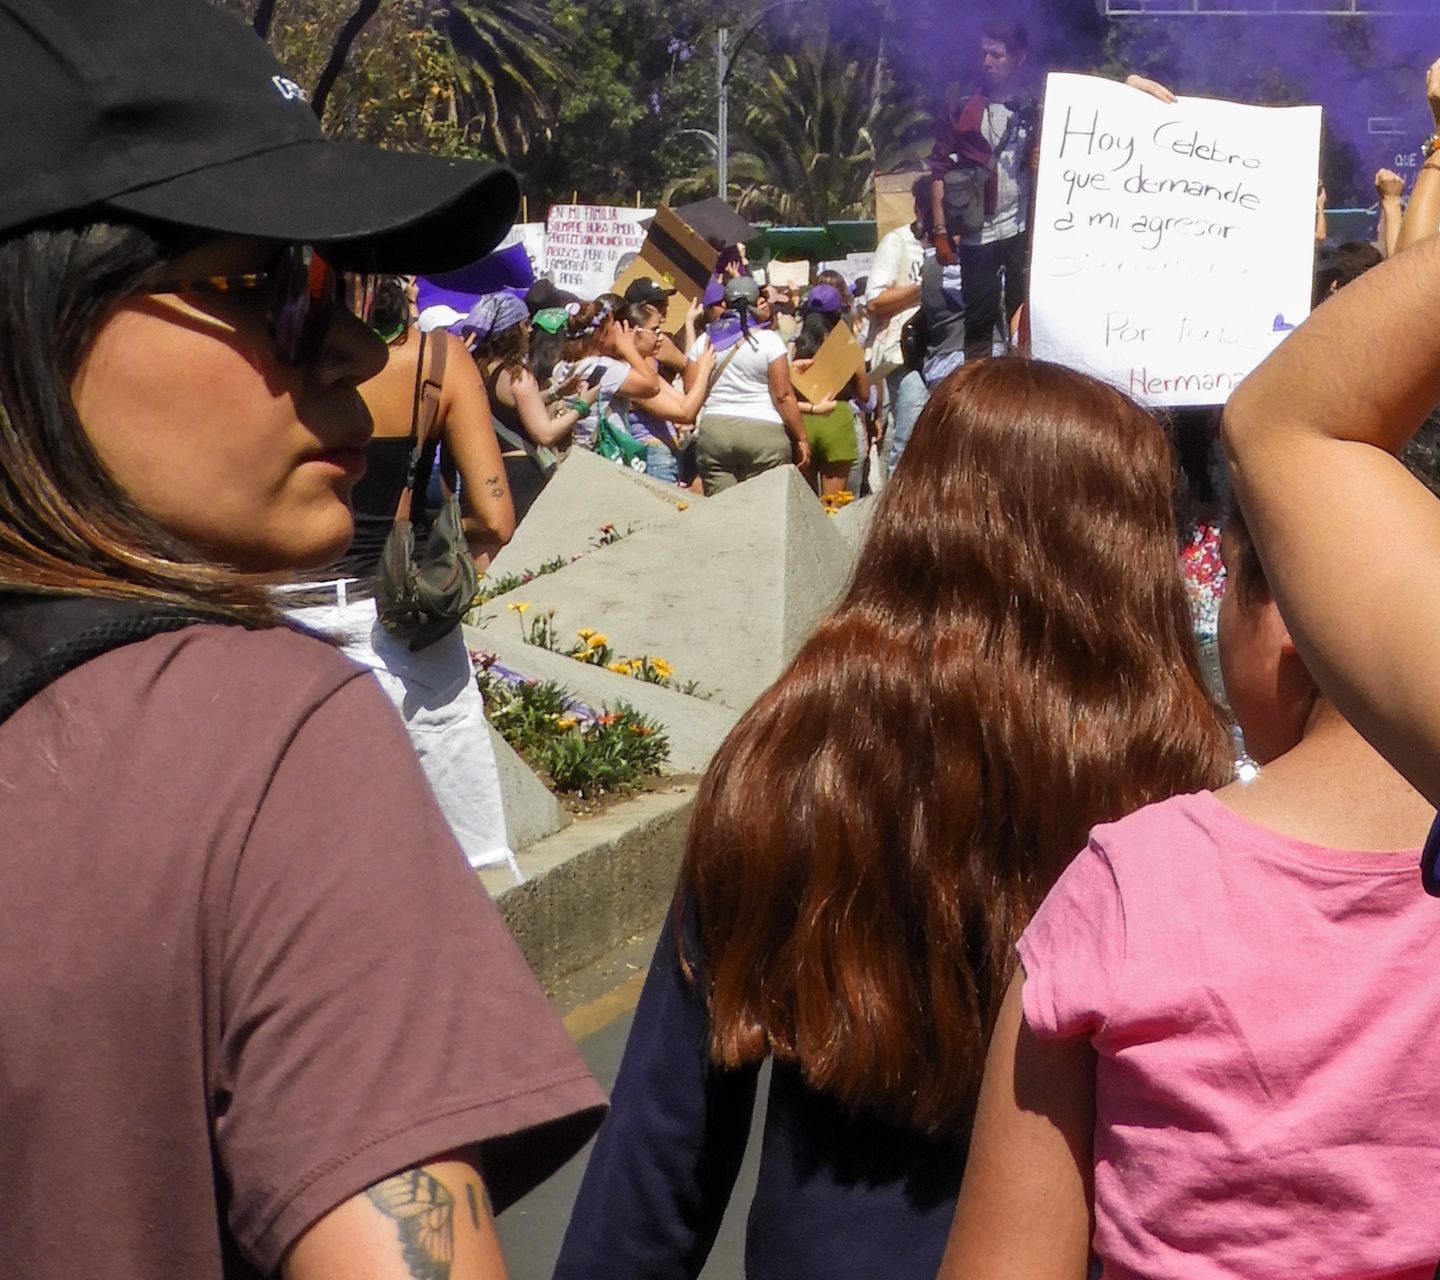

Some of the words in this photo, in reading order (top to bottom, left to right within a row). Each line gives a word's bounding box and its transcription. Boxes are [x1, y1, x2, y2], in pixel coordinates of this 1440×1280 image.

[1059, 106, 1135, 171] Hoy
[1153, 121, 1261, 170] Celebro
[1063, 169, 1112, 204] que
[1124, 164, 1261, 211] demande
[549, 221, 582, 234] SIEMPRE
[587, 222, 608, 234] HUBO
[612, 222, 635, 235] AMOR
[568, 206, 580, 220] MI
[584, 206, 618, 220] FAMILIA
[1053, 211, 1075, 231] a
[1089, 212, 1120, 230] mi
[1131, 215, 1243, 250] agresor
[583, 247, 605, 260] PERO
[1104, 311, 1152, 346] Por
